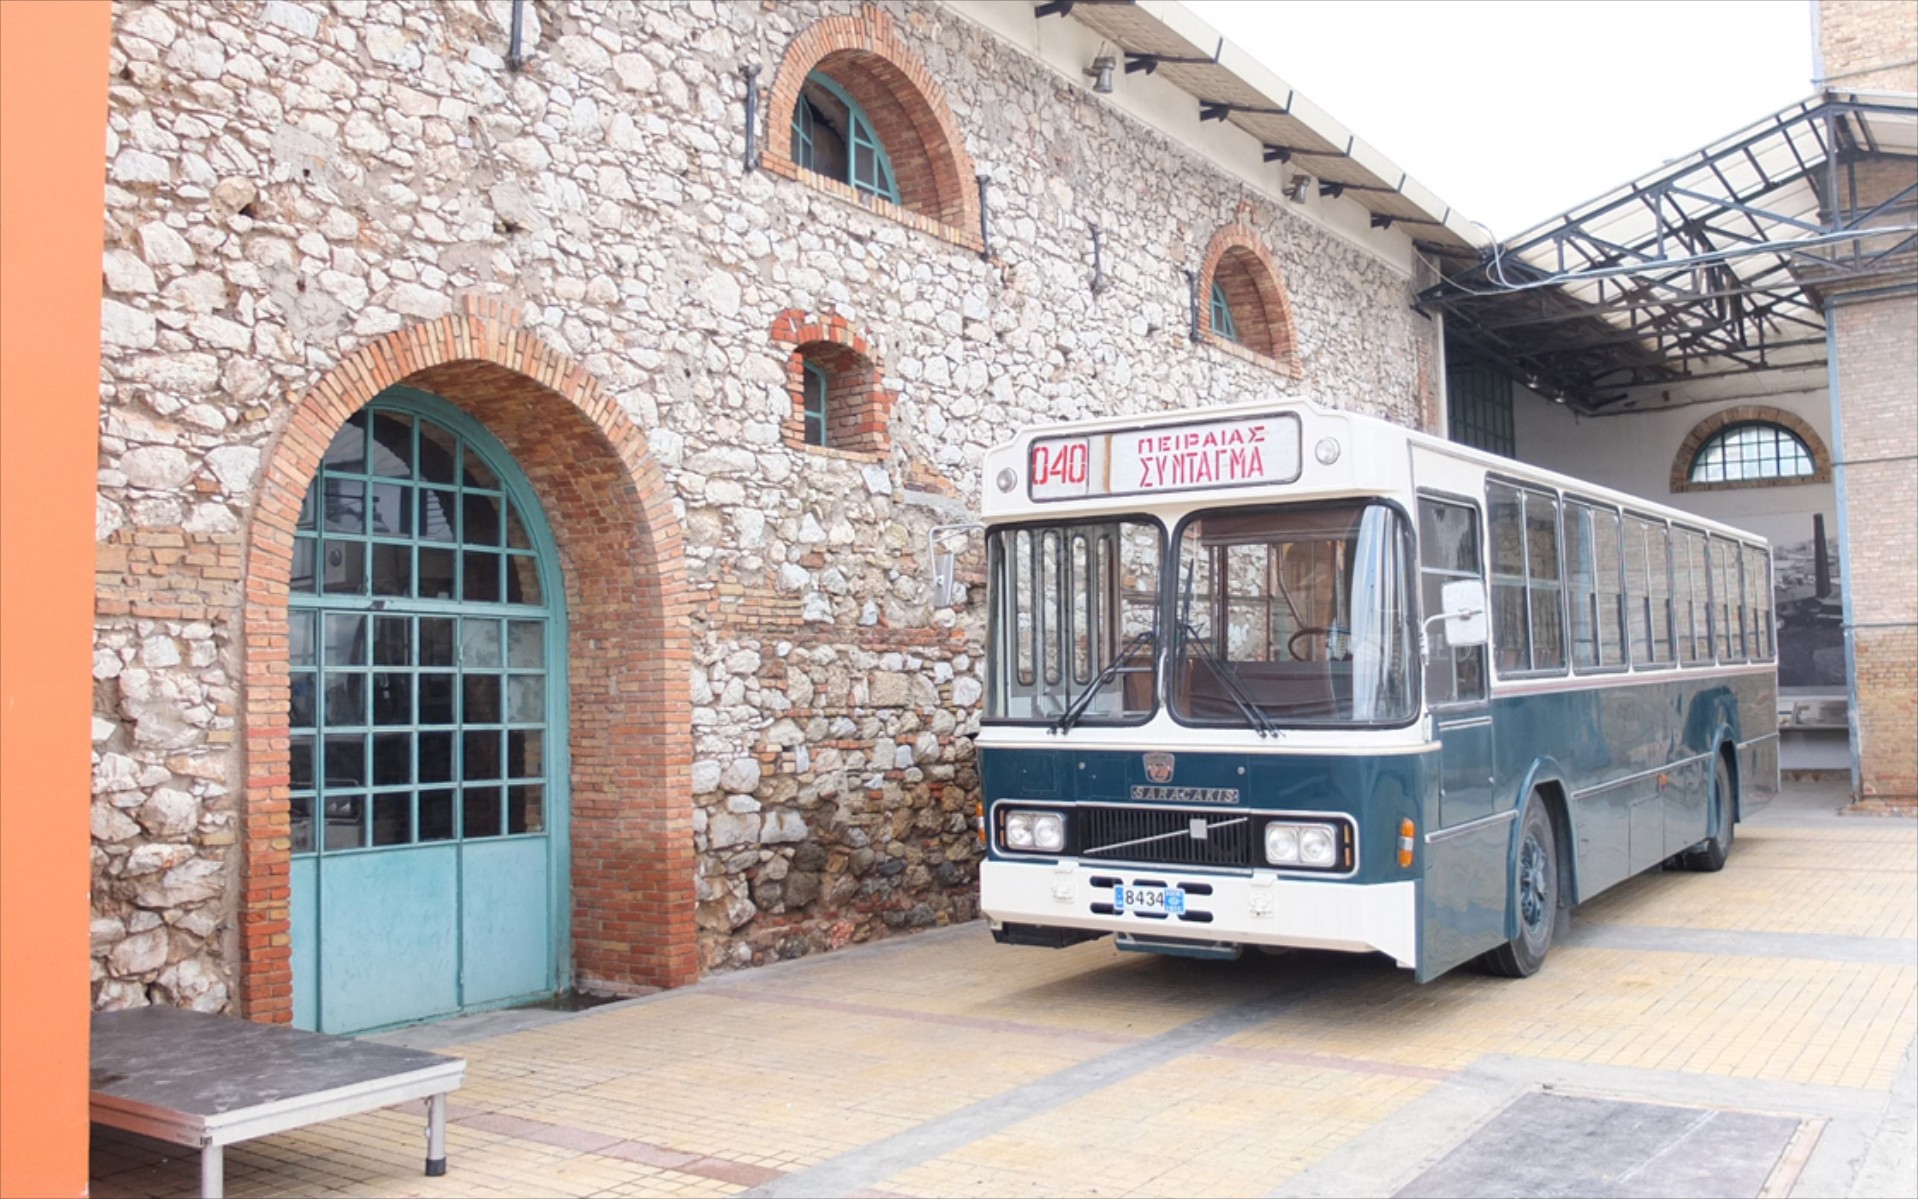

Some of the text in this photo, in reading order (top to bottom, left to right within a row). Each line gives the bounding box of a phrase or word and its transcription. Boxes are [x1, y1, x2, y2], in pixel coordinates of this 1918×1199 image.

[1138, 426, 1265, 454] ΠΕΙΡΑΙΑΣ
[1032, 445, 1087, 485] 040
[1139, 446, 1265, 487] ΣΥΝΤΑΓΜΑ
[1134, 787, 1235, 801] SARACAKIS
[1125, 890, 1165, 907] 8434
